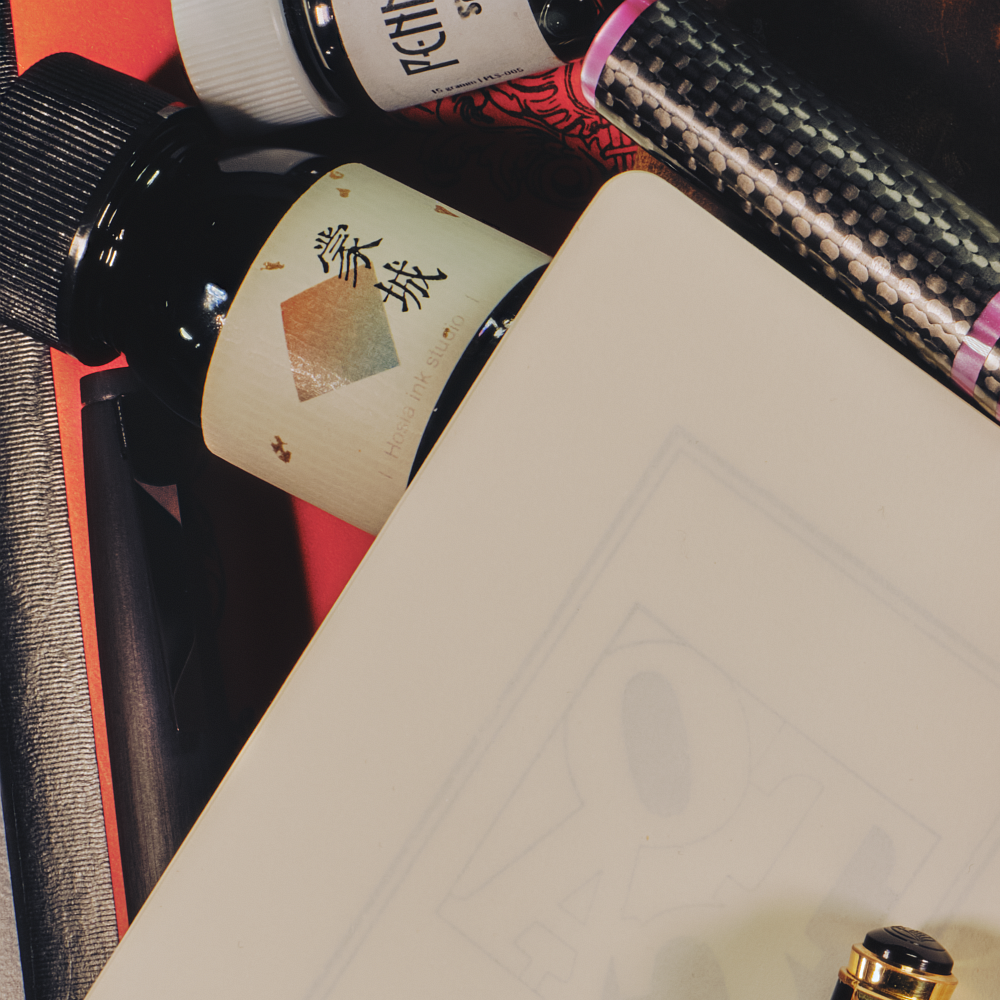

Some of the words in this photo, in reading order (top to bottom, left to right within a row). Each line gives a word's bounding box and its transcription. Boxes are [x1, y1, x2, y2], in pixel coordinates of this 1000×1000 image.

[431, 87, 443, 95] 15
[405, 370, 432, 401] ink
[426, 313, 465, 369] studio
